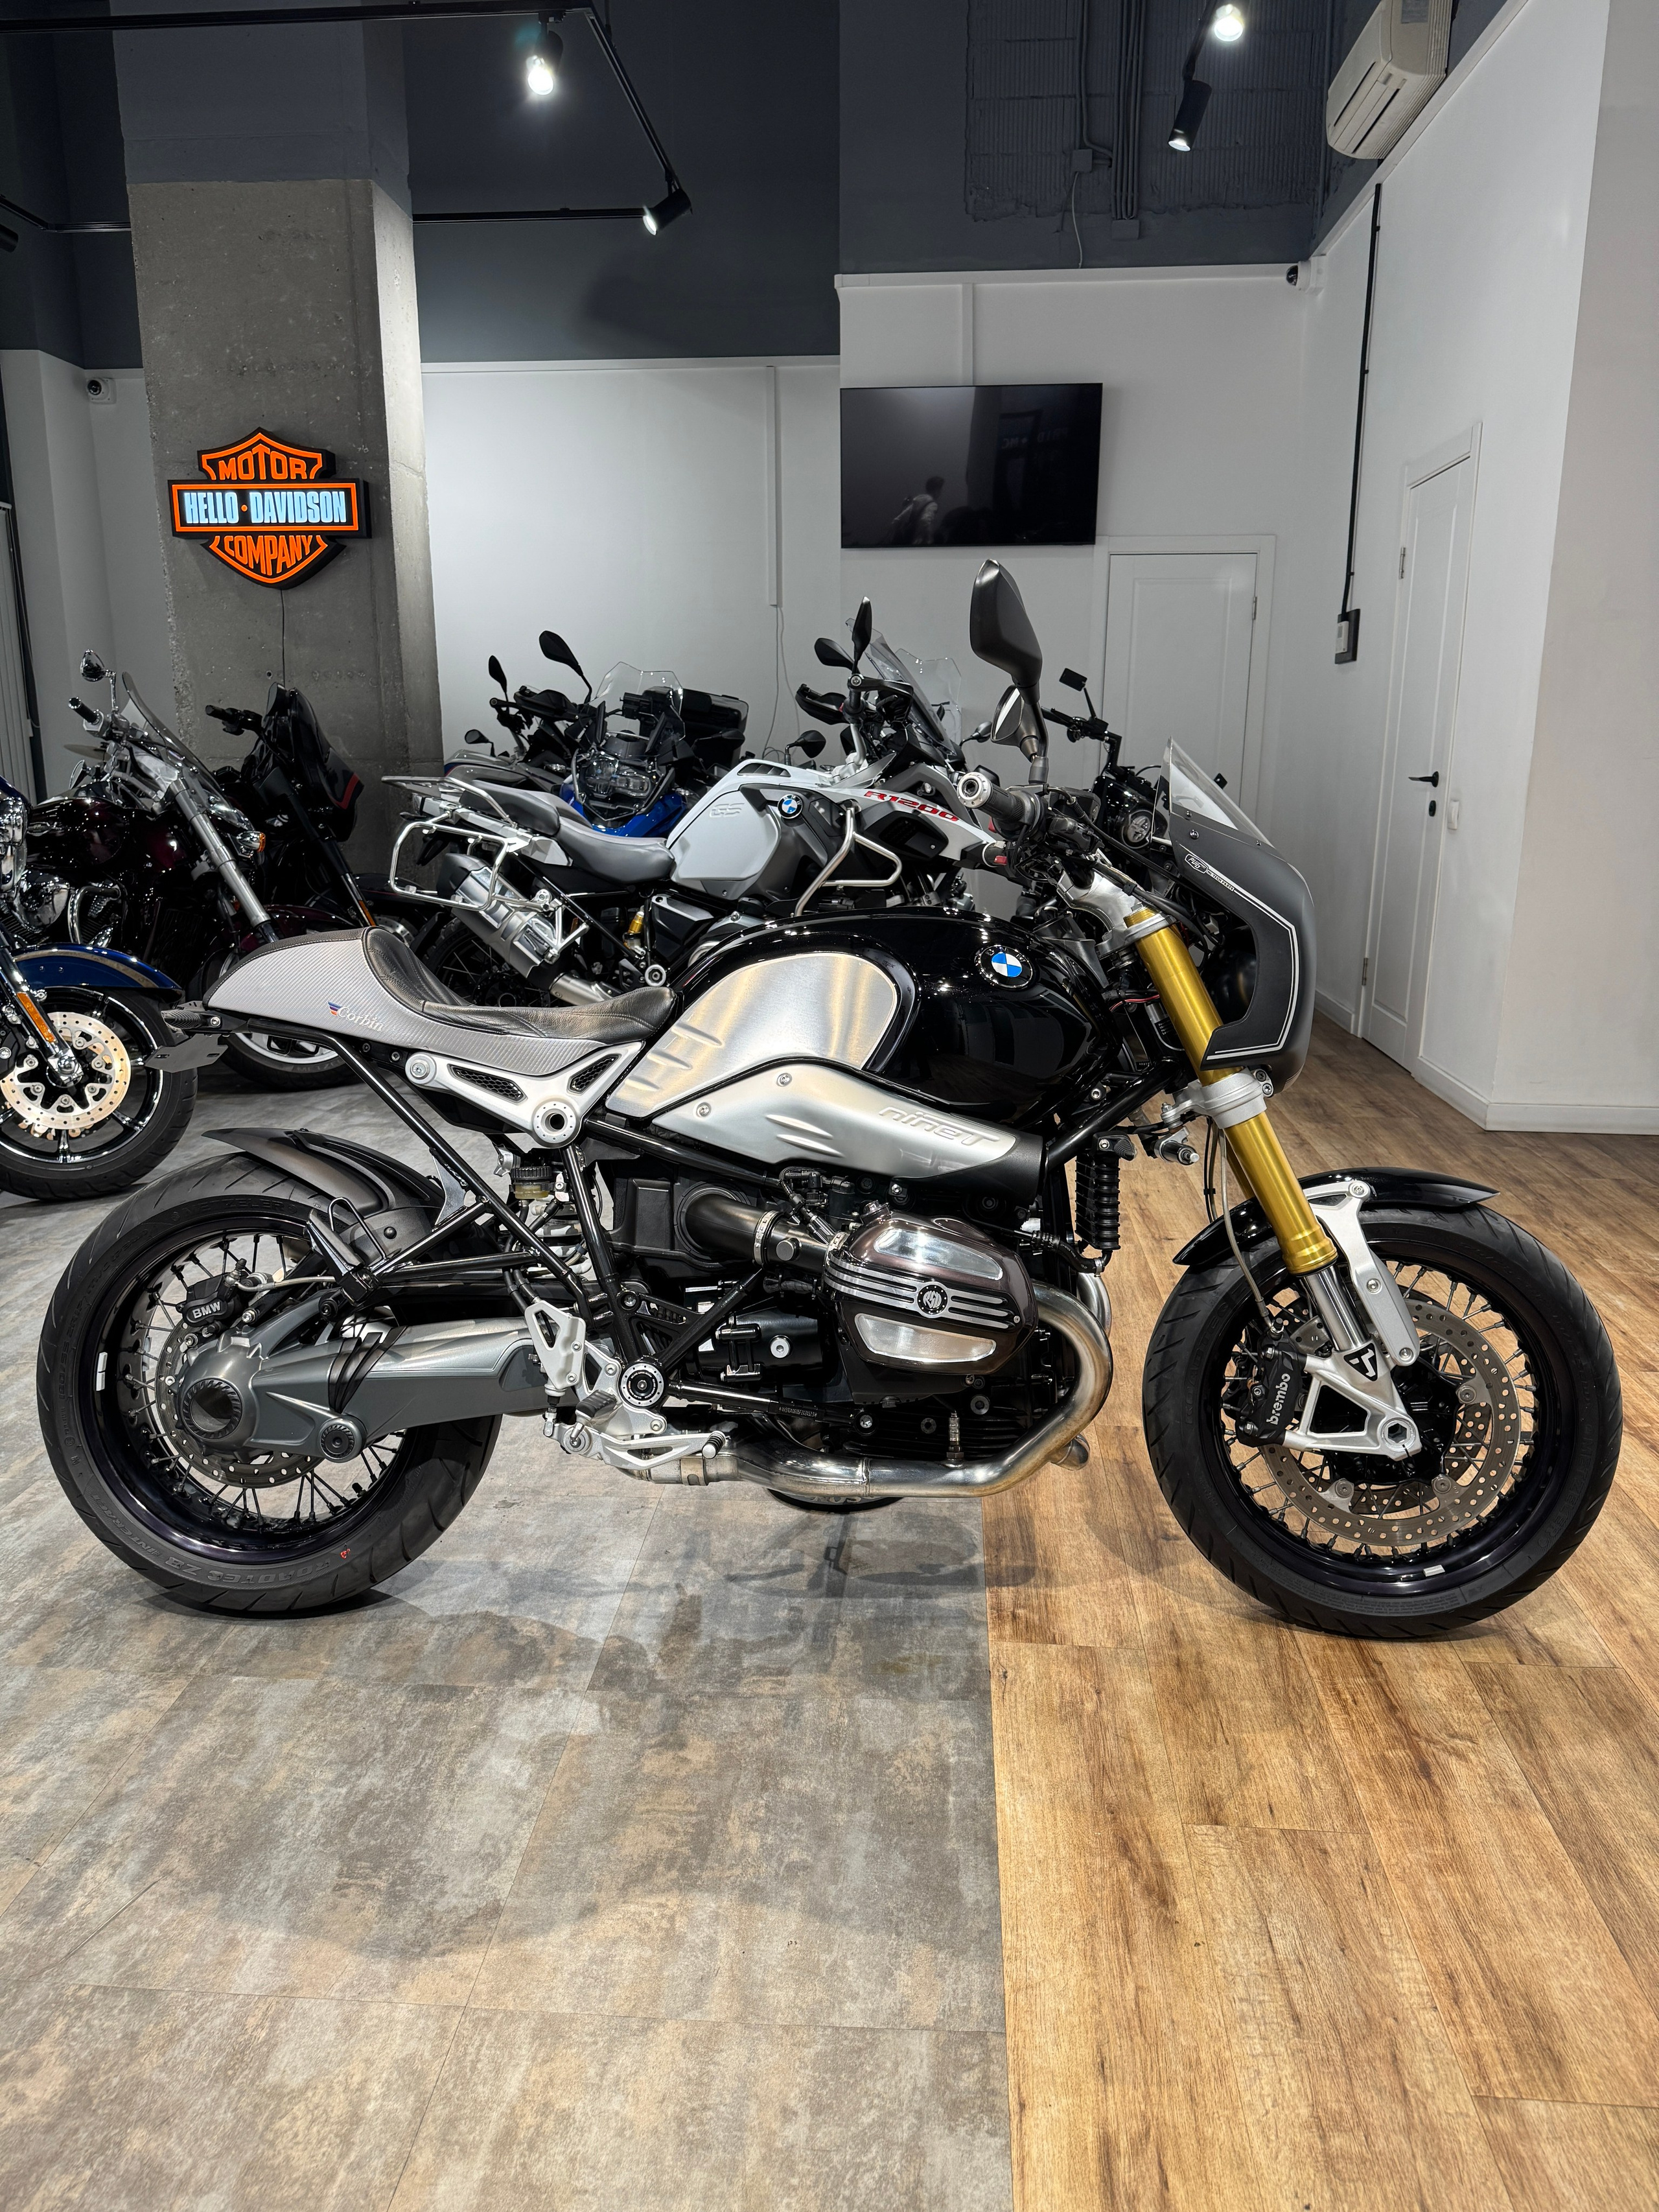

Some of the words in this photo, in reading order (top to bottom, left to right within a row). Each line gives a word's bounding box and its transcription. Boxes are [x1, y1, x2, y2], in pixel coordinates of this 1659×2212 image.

[218, 443, 307, 480] MOTOR
[183, 491, 239, 524] HELLO
[249, 491, 347, 524] DAVIDSON
[224, 535, 313, 576] COMPANY
[709, 802, 745, 818] GS
[864, 791, 960, 821] R1200
[1188, 857, 1206, 869] PUIG
[336, 1007, 384, 1032] Corbin
[192, 1301, 220, 1319] BMW
[1266, 1373, 1291, 1425] brembo
[91, 1493, 156, 1555] INTERACT
[165, 1555, 202, 1576] Z8
[207, 1558, 332, 1584] ROADTEC
